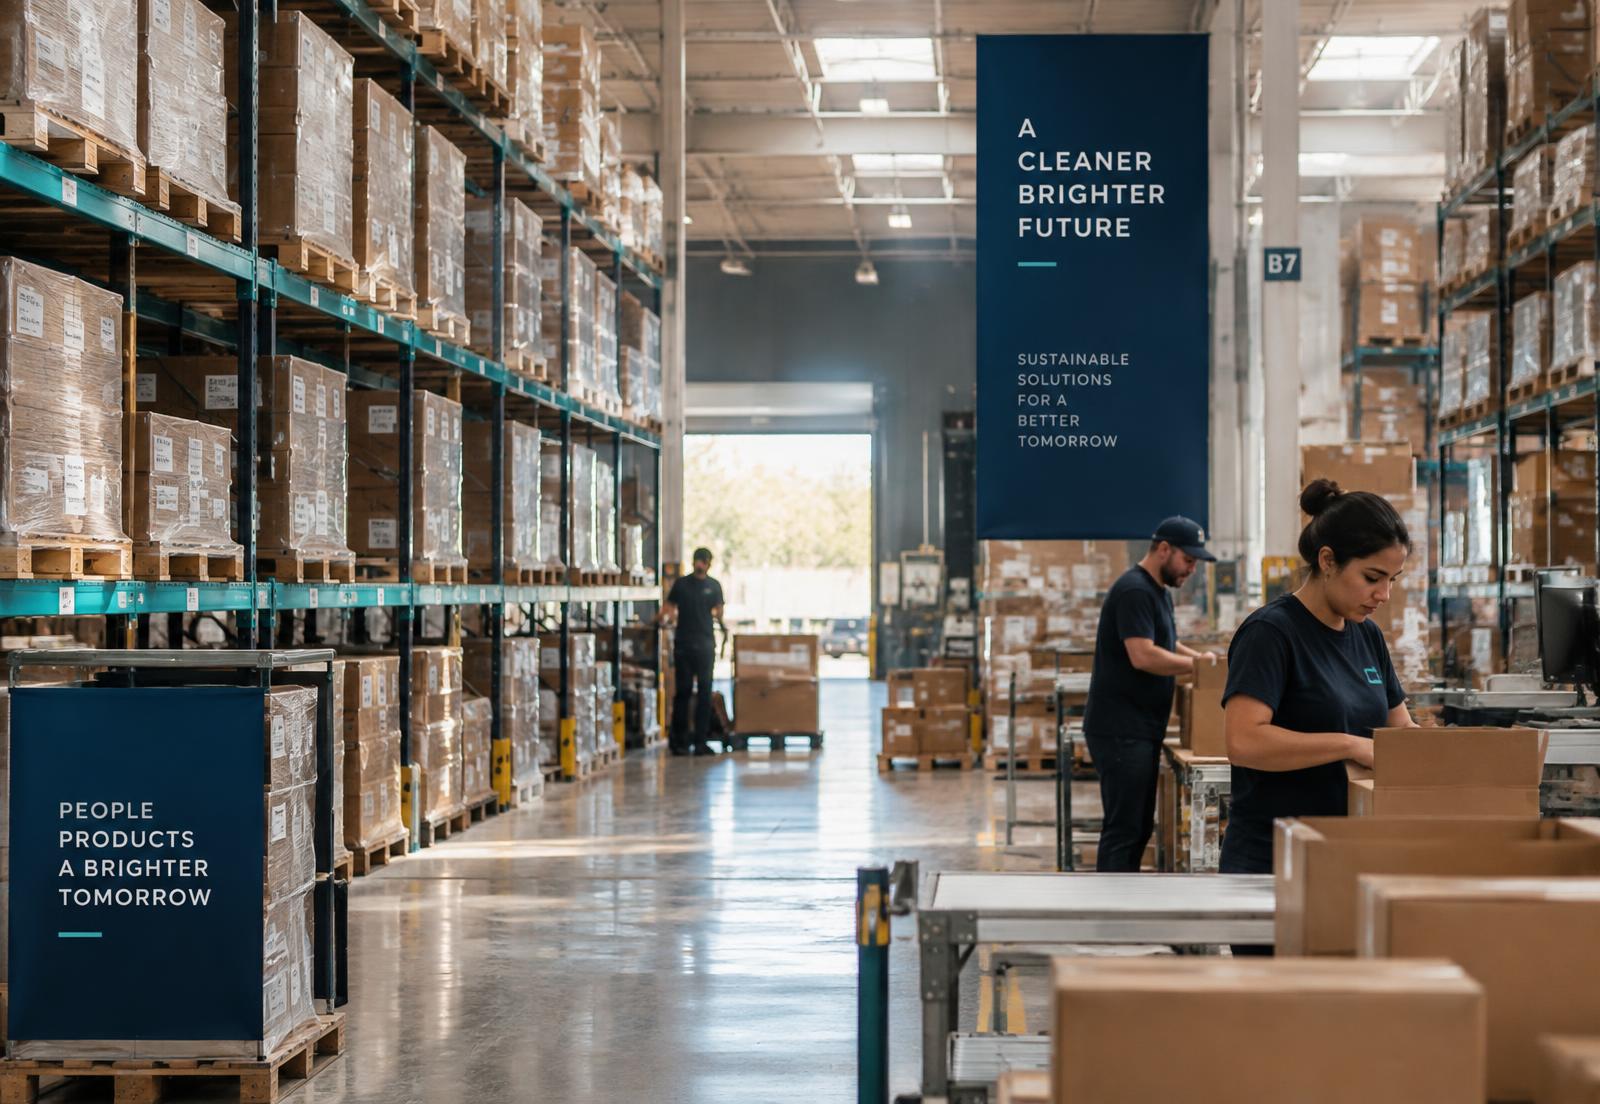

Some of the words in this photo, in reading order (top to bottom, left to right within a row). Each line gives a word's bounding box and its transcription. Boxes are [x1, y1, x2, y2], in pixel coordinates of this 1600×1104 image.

[1018, 118, 1037, 138] A
[1018, 151, 1152, 171] CLEANER
[1019, 184, 1165, 204] BRIGHTER
[1018, 218, 1131, 237] FUTURE
[1269, 254, 1297, 273] B7
[1018, 353, 1129, 365] SUSTAINABLE
[1018, 374, 1112, 386] SOLUTIONS
[1018, 394, 1050, 406] FOR
[1057, 394, 1067, 406] A
[1018, 414, 1080, 427] BETTER
[1018, 435, 1118, 447] TOMORROW
[59, 802, 153, 819] PEOPLE
[59, 830, 194, 848] PRODUCTS
[58, 859, 75, 877] A
[84, 859, 208, 877] BRIGHTER
[58, 888, 212, 906] TOMORROW
